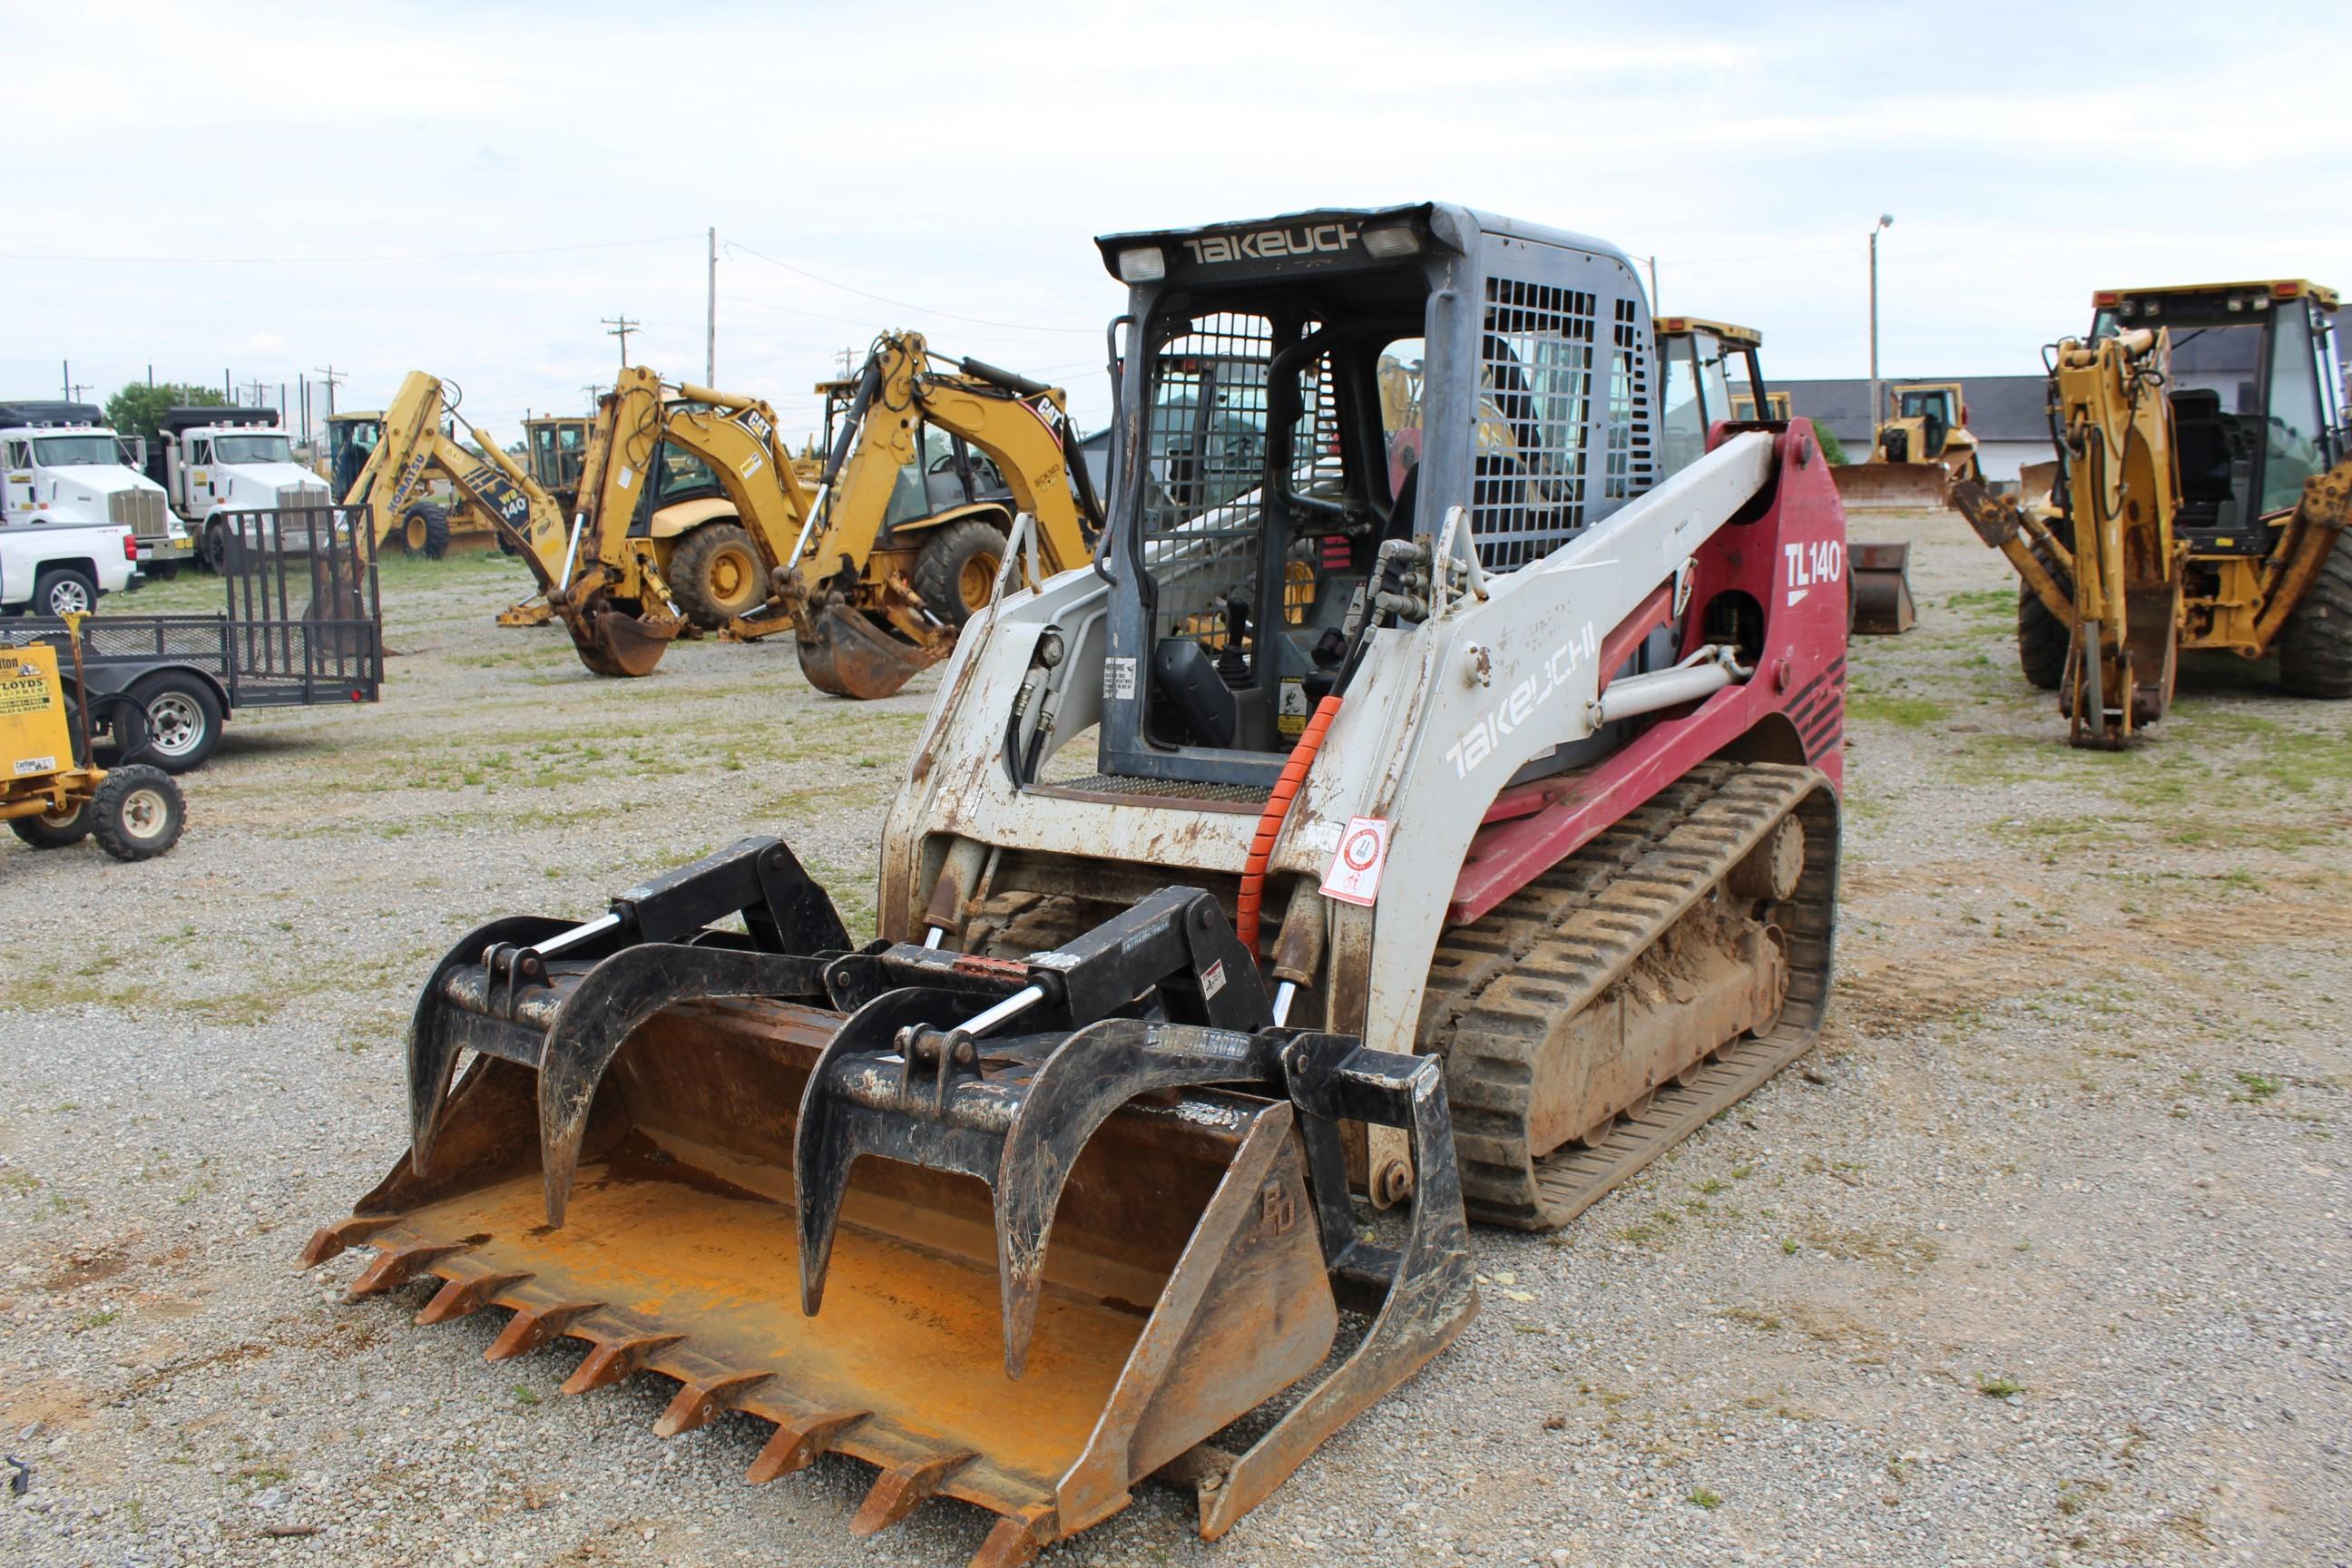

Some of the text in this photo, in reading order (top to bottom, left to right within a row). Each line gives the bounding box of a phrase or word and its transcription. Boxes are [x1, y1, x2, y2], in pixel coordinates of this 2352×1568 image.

[1182, 221, 1362, 264] TAKEUCH
[748, 411, 771, 439] CAT
[1036, 397, 1062, 427] CAT
[387, 454, 425, 515] KOMATSU
[499, 489, 518, 505] WB
[501, 498, 526, 519] 140
[0, 679, 43, 691] LOYDS
[1446, 620, 1596, 780] TAKEUCHI
